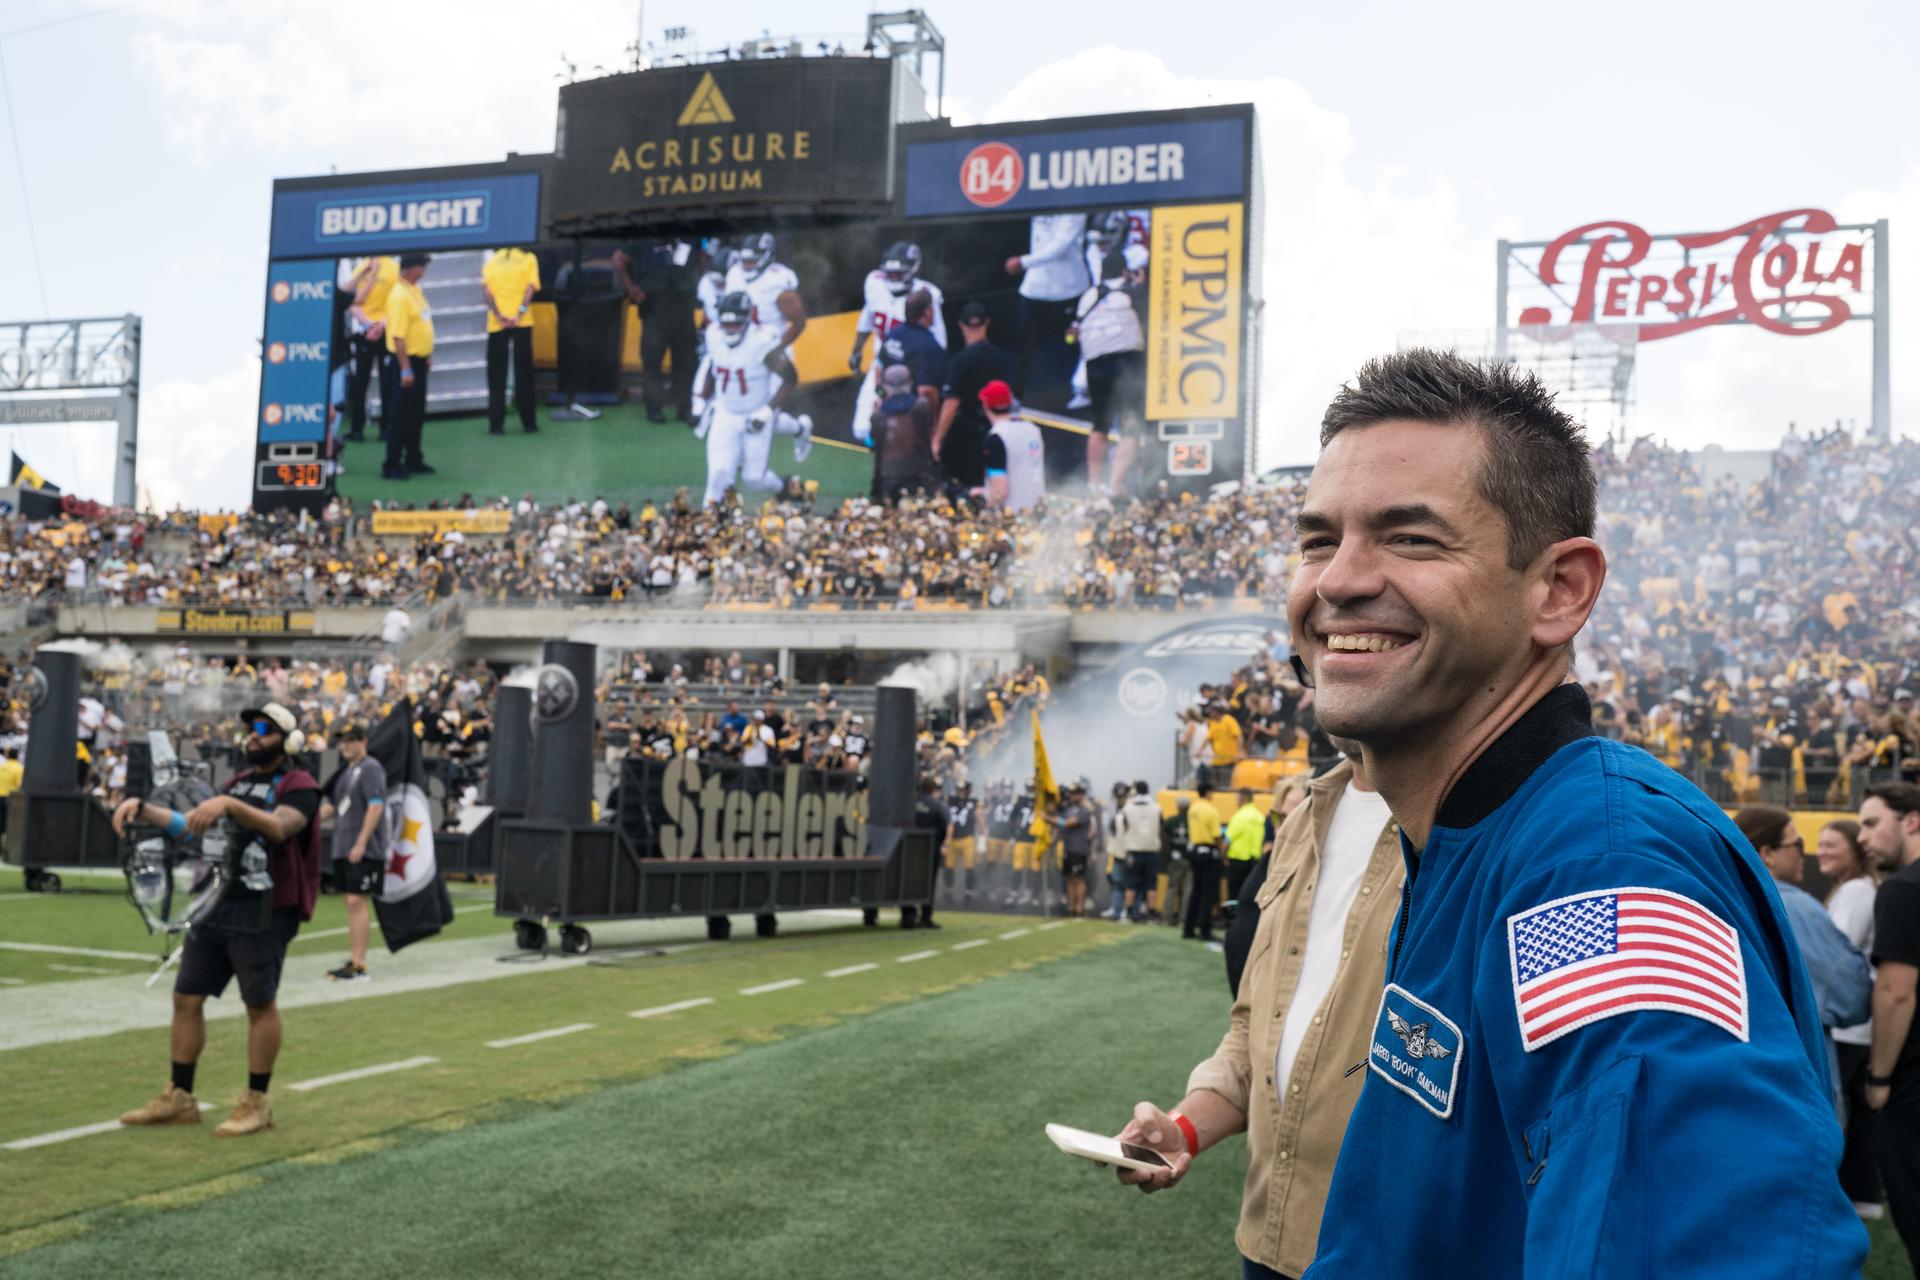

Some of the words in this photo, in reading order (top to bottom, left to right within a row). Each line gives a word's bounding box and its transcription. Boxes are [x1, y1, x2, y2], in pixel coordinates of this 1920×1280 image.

[609, 131, 810, 174] ACRISURE
[643, 169, 762, 197] STADIUM
[967, 155, 1014, 194] 84
[1028, 143, 1184, 190] LUMBER
[322, 206, 388, 235] BUD
[390, 198, 483, 230] LIGHT
[1162, 223, 1172, 253] LIFE
[292, 281, 331, 301] PNC
[1160, 257, 1172, 332] CHANGING
[1178, 216, 1230, 405] UPMC
[288, 342, 328, 362] PNC
[716, 367, 748, 396] 71
[1158, 337, 1171, 405] MEDICINE
[284, 403, 324, 423] PNC
[277, 463, 319, 487] 9:30
[185, 609, 284, 632] Steelers.com
[659, 752, 870, 859] Steelers
